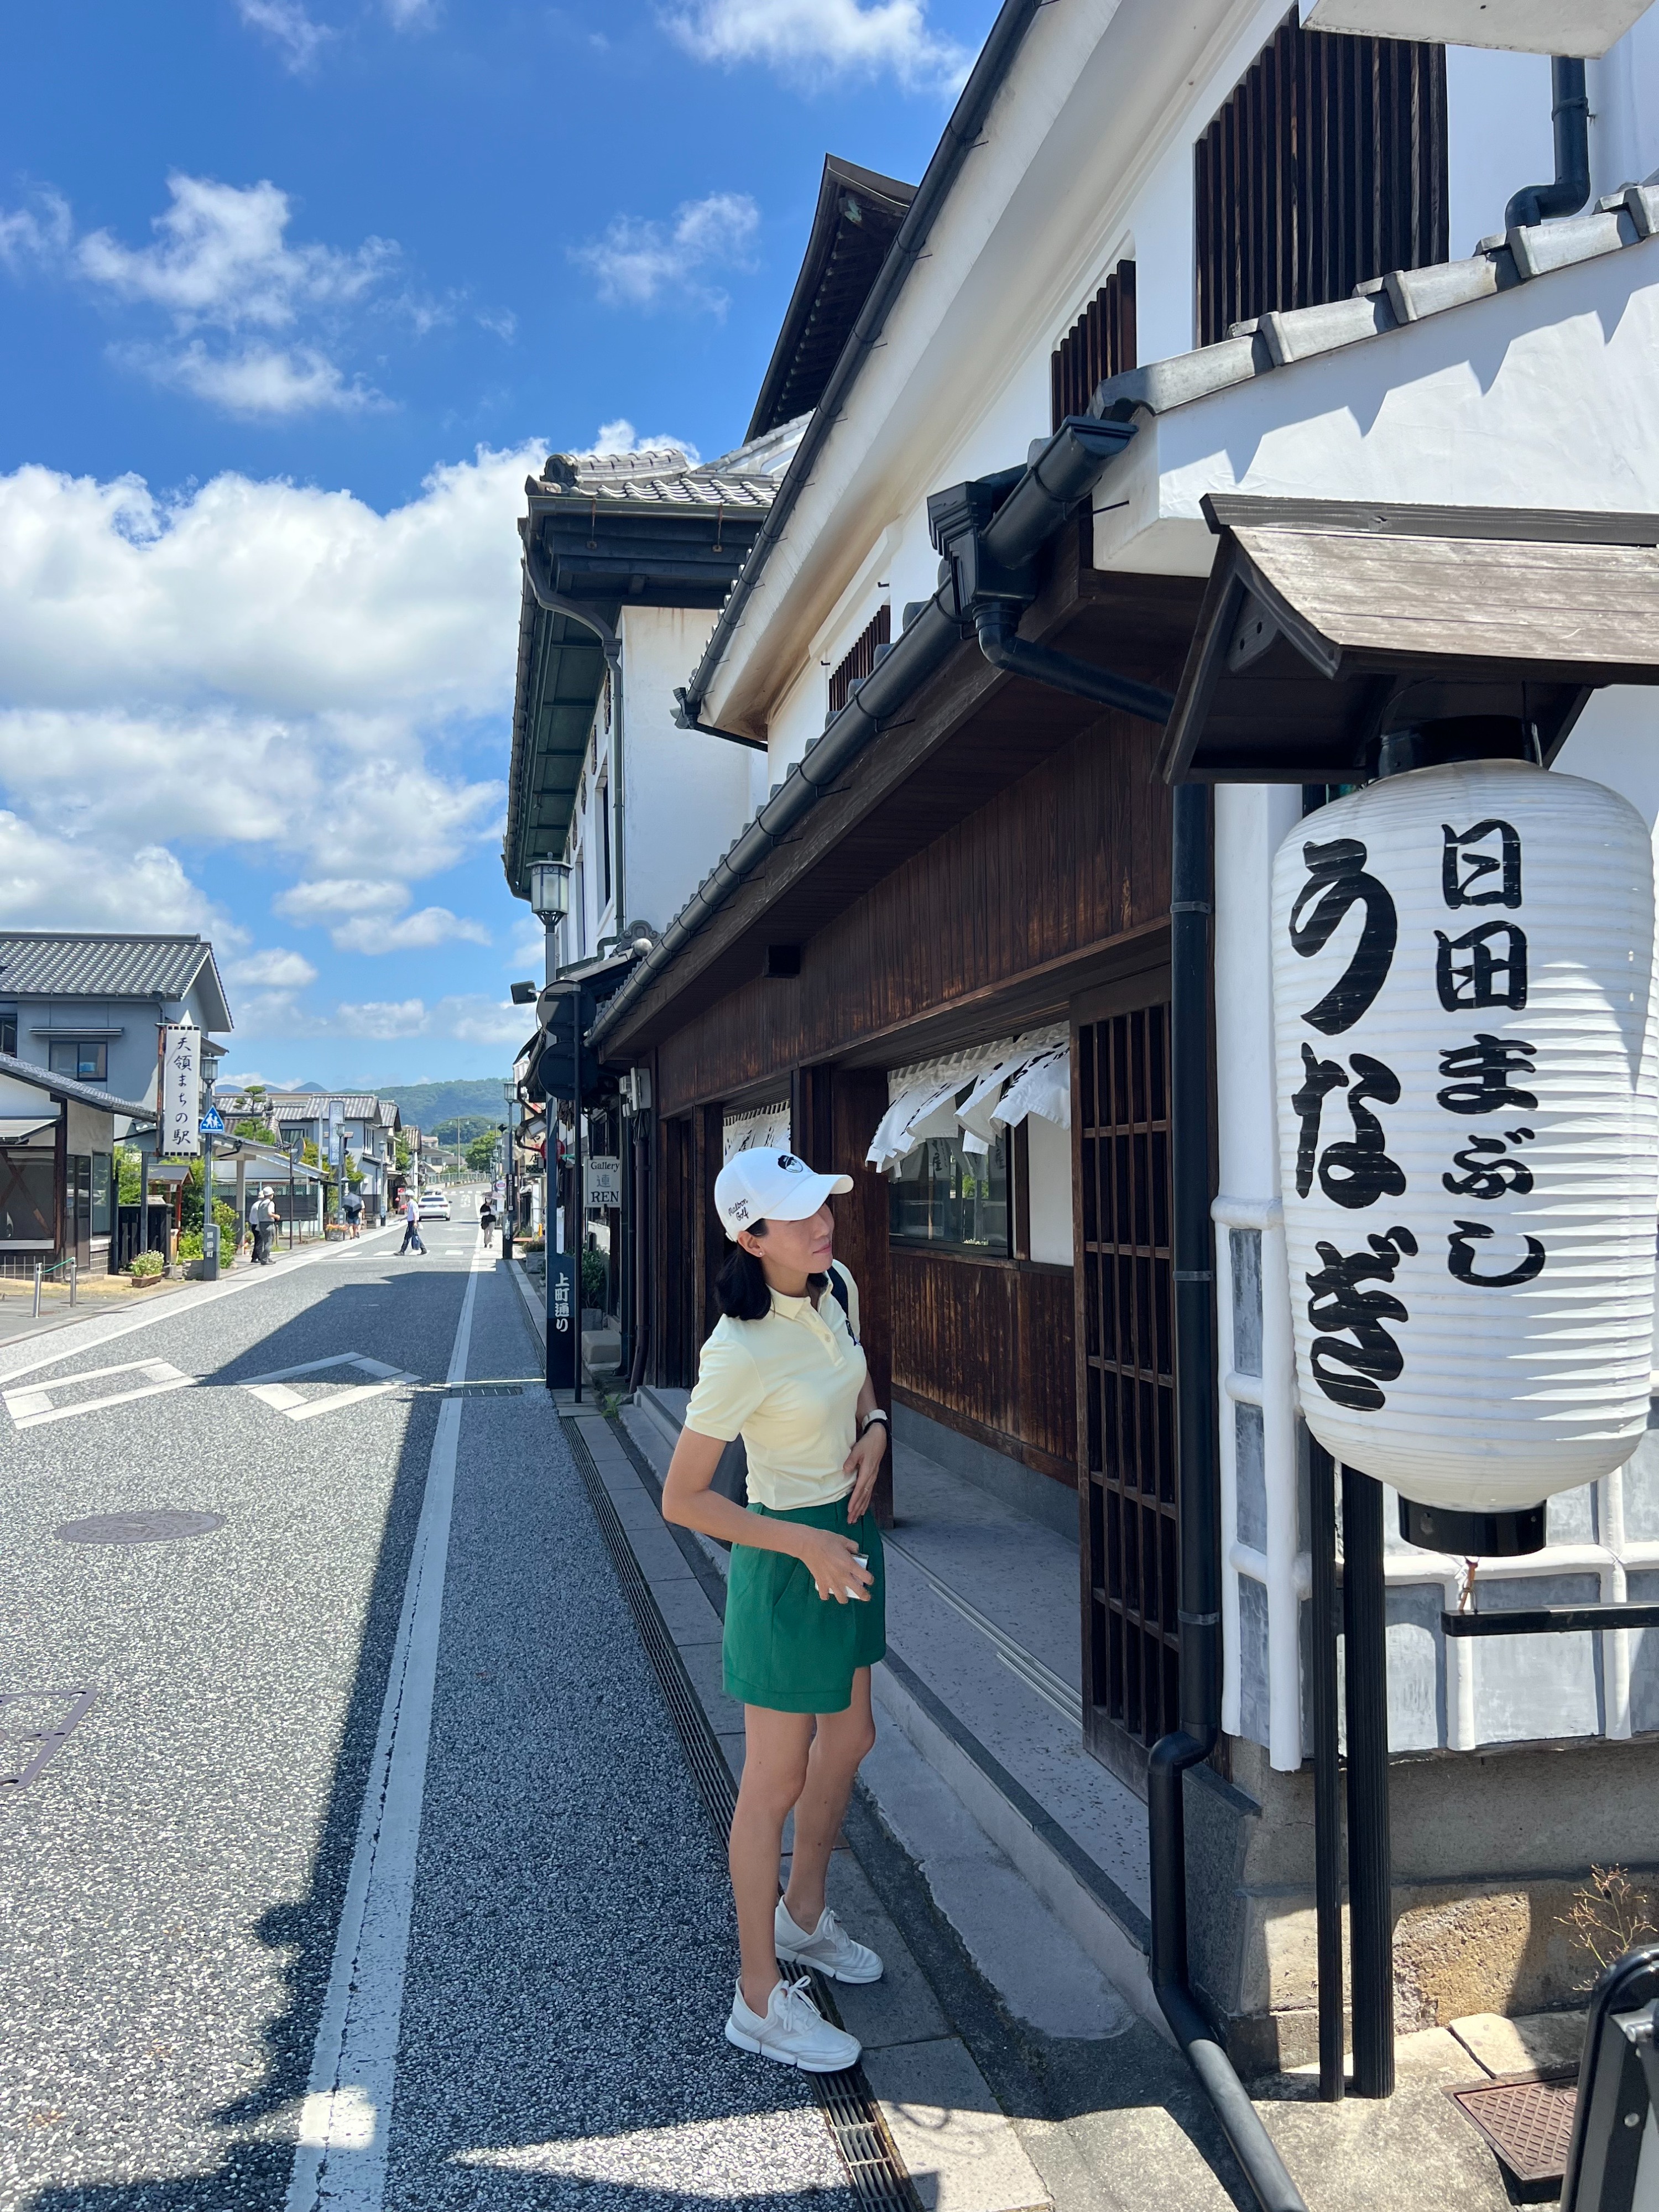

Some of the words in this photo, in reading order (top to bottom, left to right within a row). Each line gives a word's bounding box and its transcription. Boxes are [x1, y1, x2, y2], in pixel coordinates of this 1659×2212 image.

[1434, 820, 1545, 1287] 日田まぶし
[172, 1037, 192, 1145] 天領まちの駅
[1289, 839, 1418, 1411] うなぎ
[591, 1161, 620, 1172] Gallery
[596, 1174, 611, 1188] 連
[591, 1191, 619, 1203] REN
[736, 1207, 749, 1221] Golf
[555, 1272, 570, 1332] 上町通り
